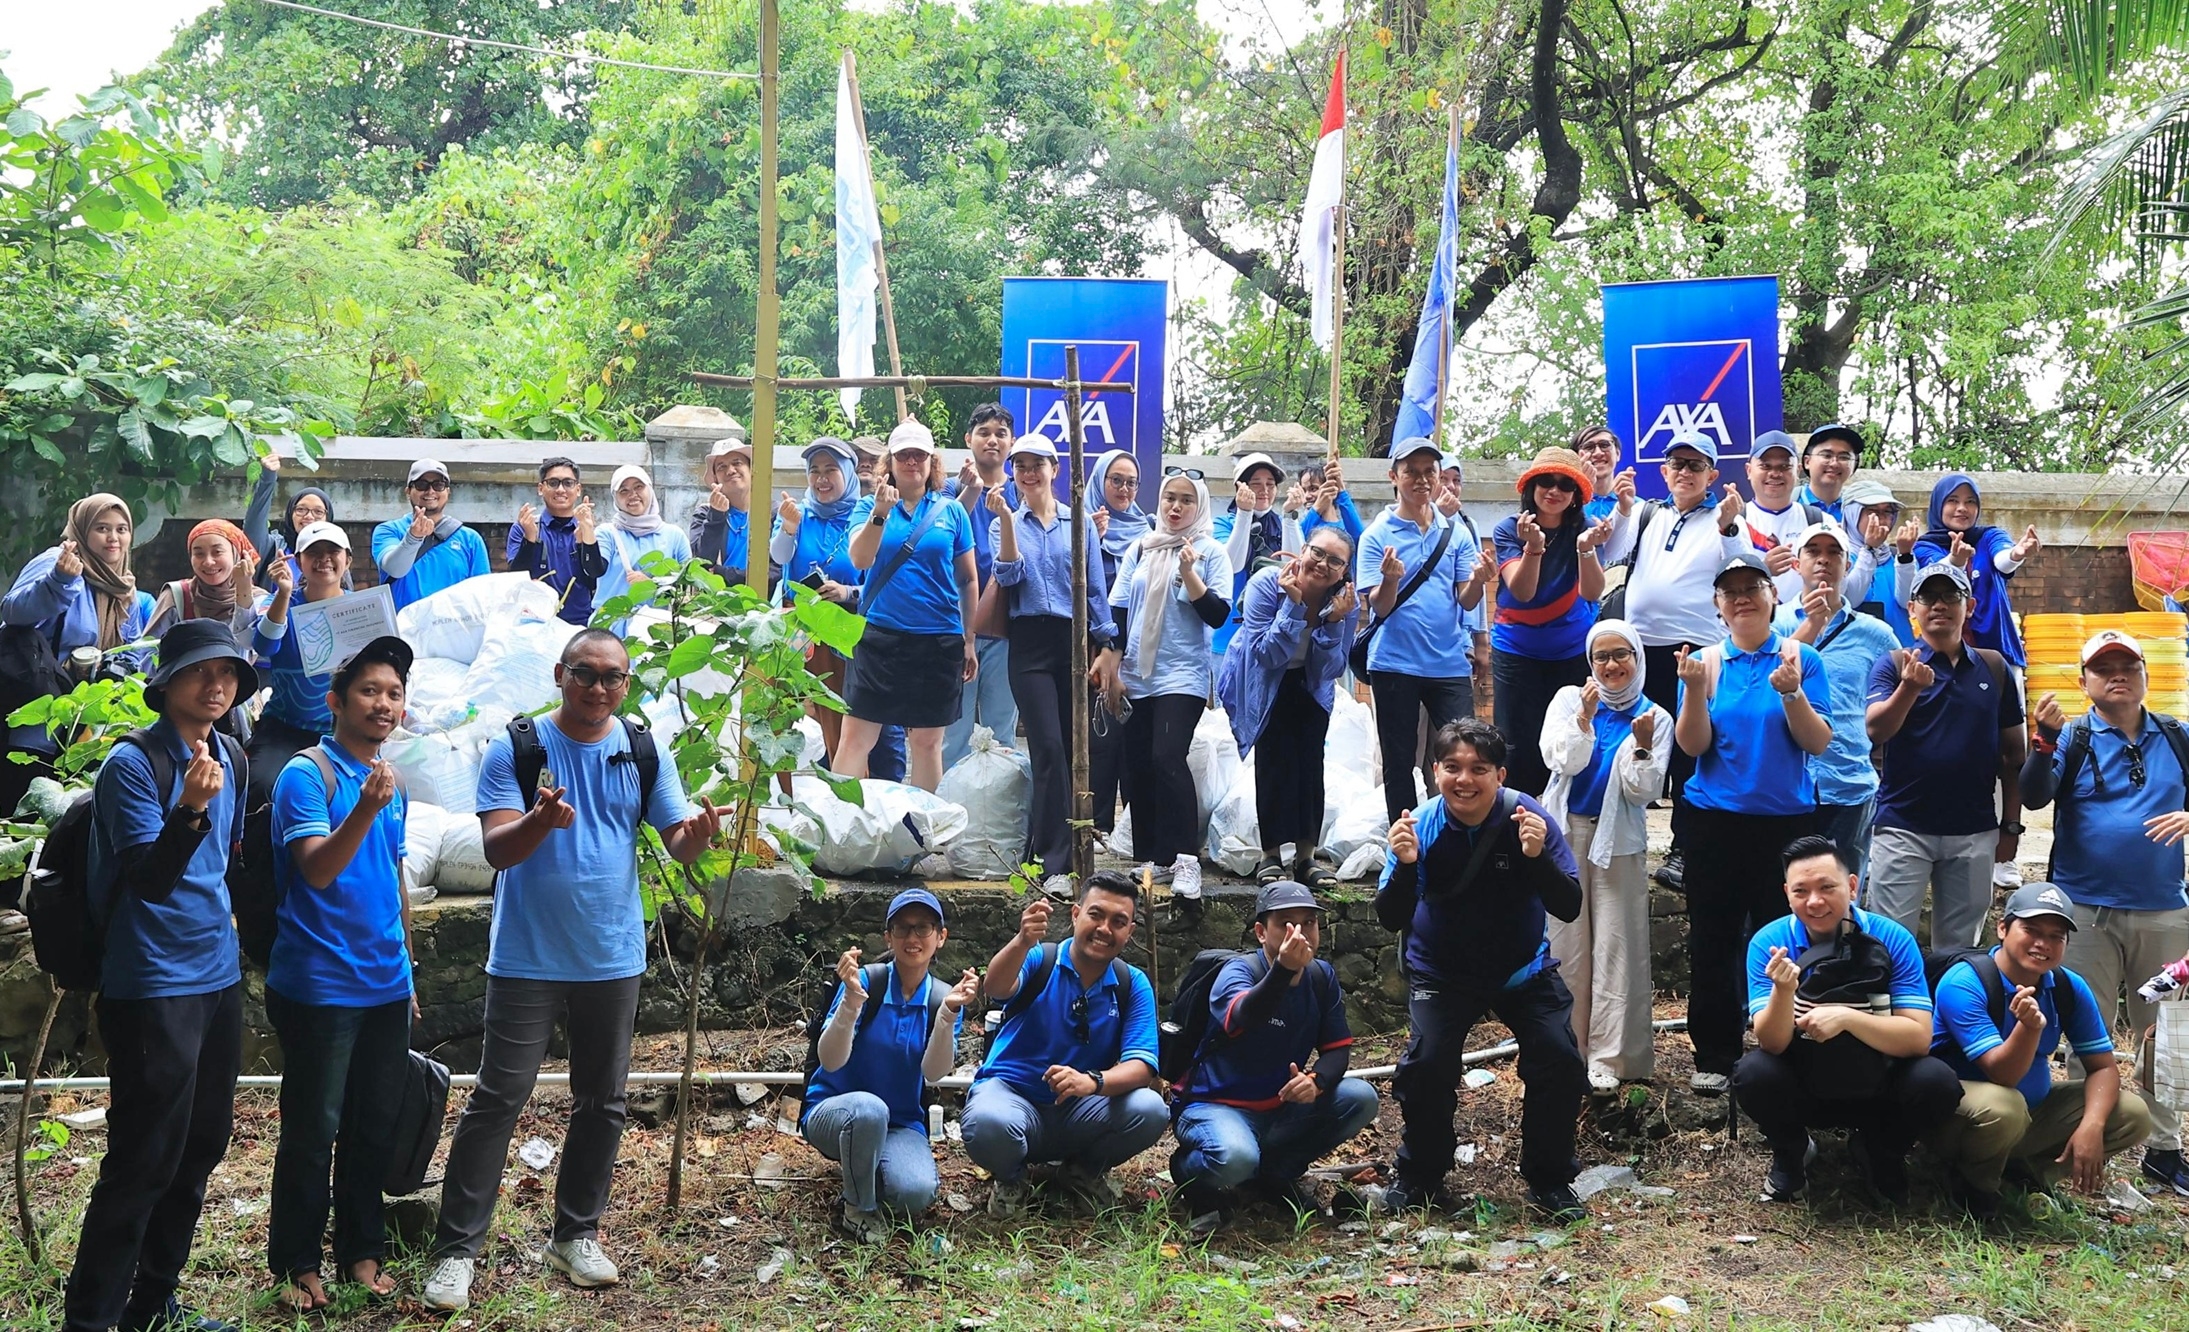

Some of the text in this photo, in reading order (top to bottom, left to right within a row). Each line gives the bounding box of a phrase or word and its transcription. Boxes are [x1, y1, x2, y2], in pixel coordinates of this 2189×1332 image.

[1031, 400, 1116, 444] AXA
[1639, 402, 1733, 449] AXA
[331, 603, 376, 619] CERTIFICATE
